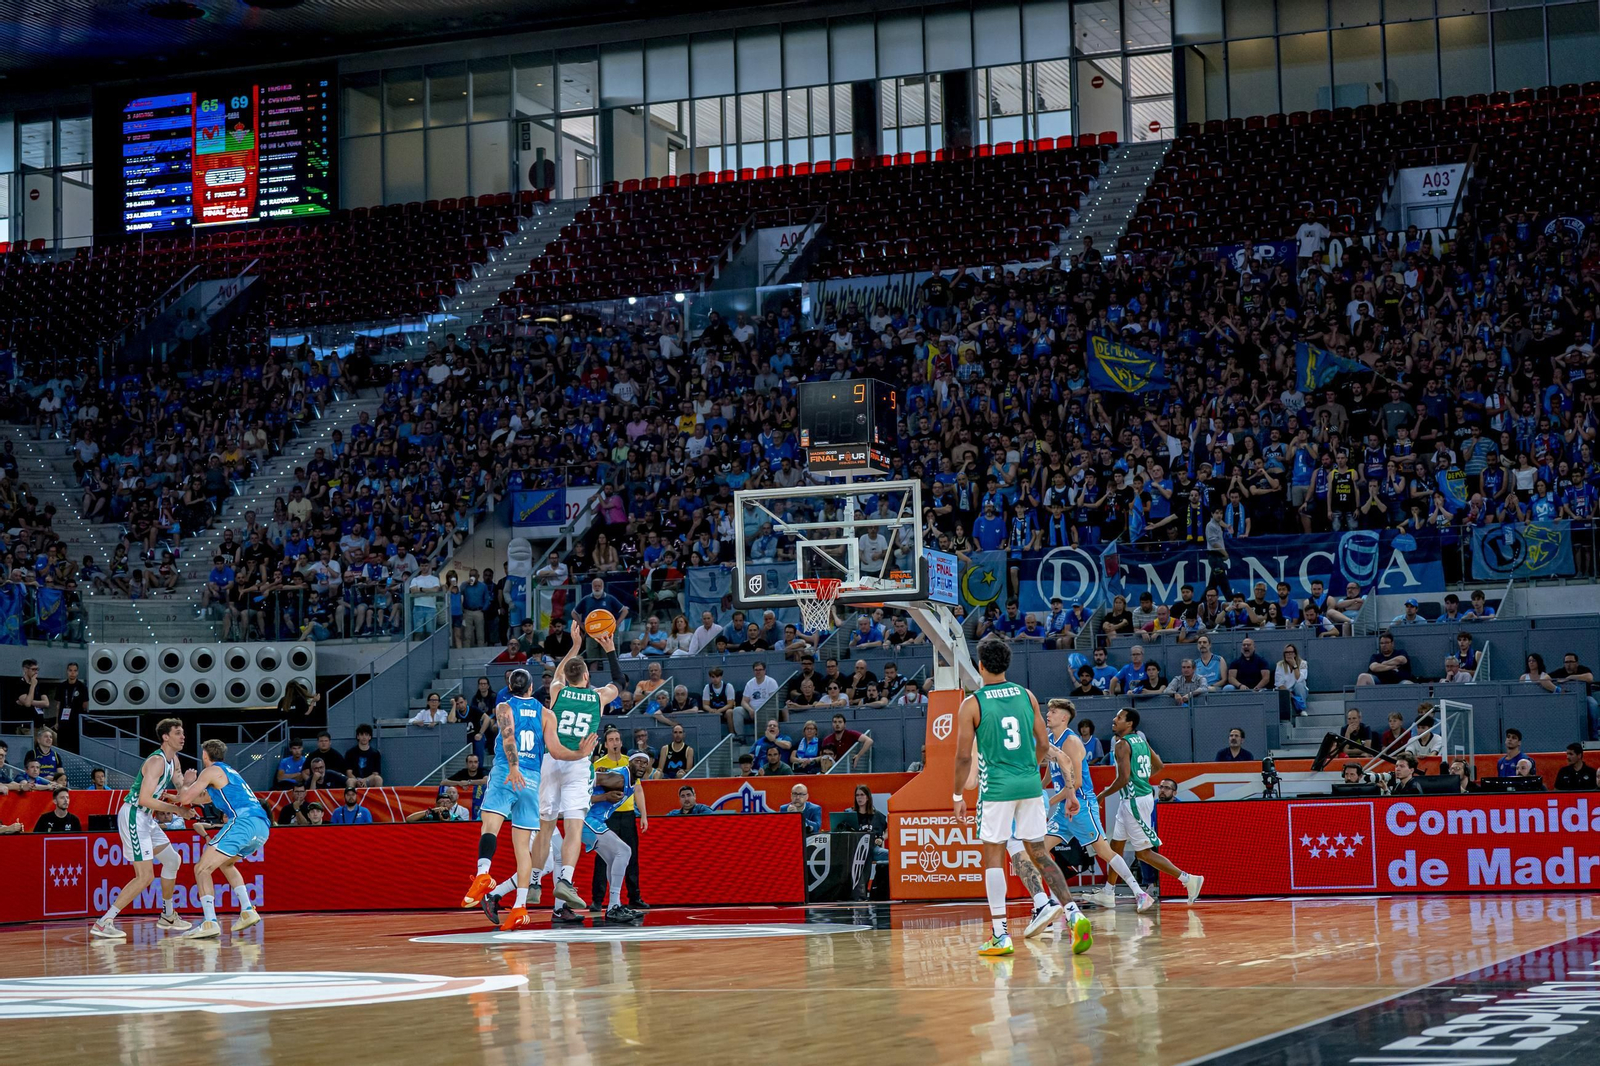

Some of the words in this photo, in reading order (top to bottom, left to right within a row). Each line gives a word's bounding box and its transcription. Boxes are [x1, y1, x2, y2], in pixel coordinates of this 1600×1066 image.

[201, 99, 219, 112] 65
[231, 96, 249, 109] 69
[1422, 172, 1450, 188] A03
[205, 190, 211, 200] 1
[239, 187, 246, 197] 2
[780, 233, 805, 247] A0
[217, 284, 238, 298] A01
[853, 384, 866, 403] 9
[889, 390, 898, 410] 9
[809, 454, 838, 463] FINAL
[838, 452, 866, 462] FOUR
[1339, 493, 1348, 502] 12
[1575, 508, 1584, 516] 51
[937, 563, 953, 577] FINAL
[984, 686, 1021, 700] HUGHES
[557, 710, 593, 738] 25
[519, 729, 535, 752] 10
[1001, 716, 1022, 751] 3
[900, 827, 984, 846] FINAL
[900, 850, 983, 873] FOUR
[1387, 849, 1450, 887] de
[901, 874, 957, 883] PRIMERA
[958, 873, 983, 882] FEB
